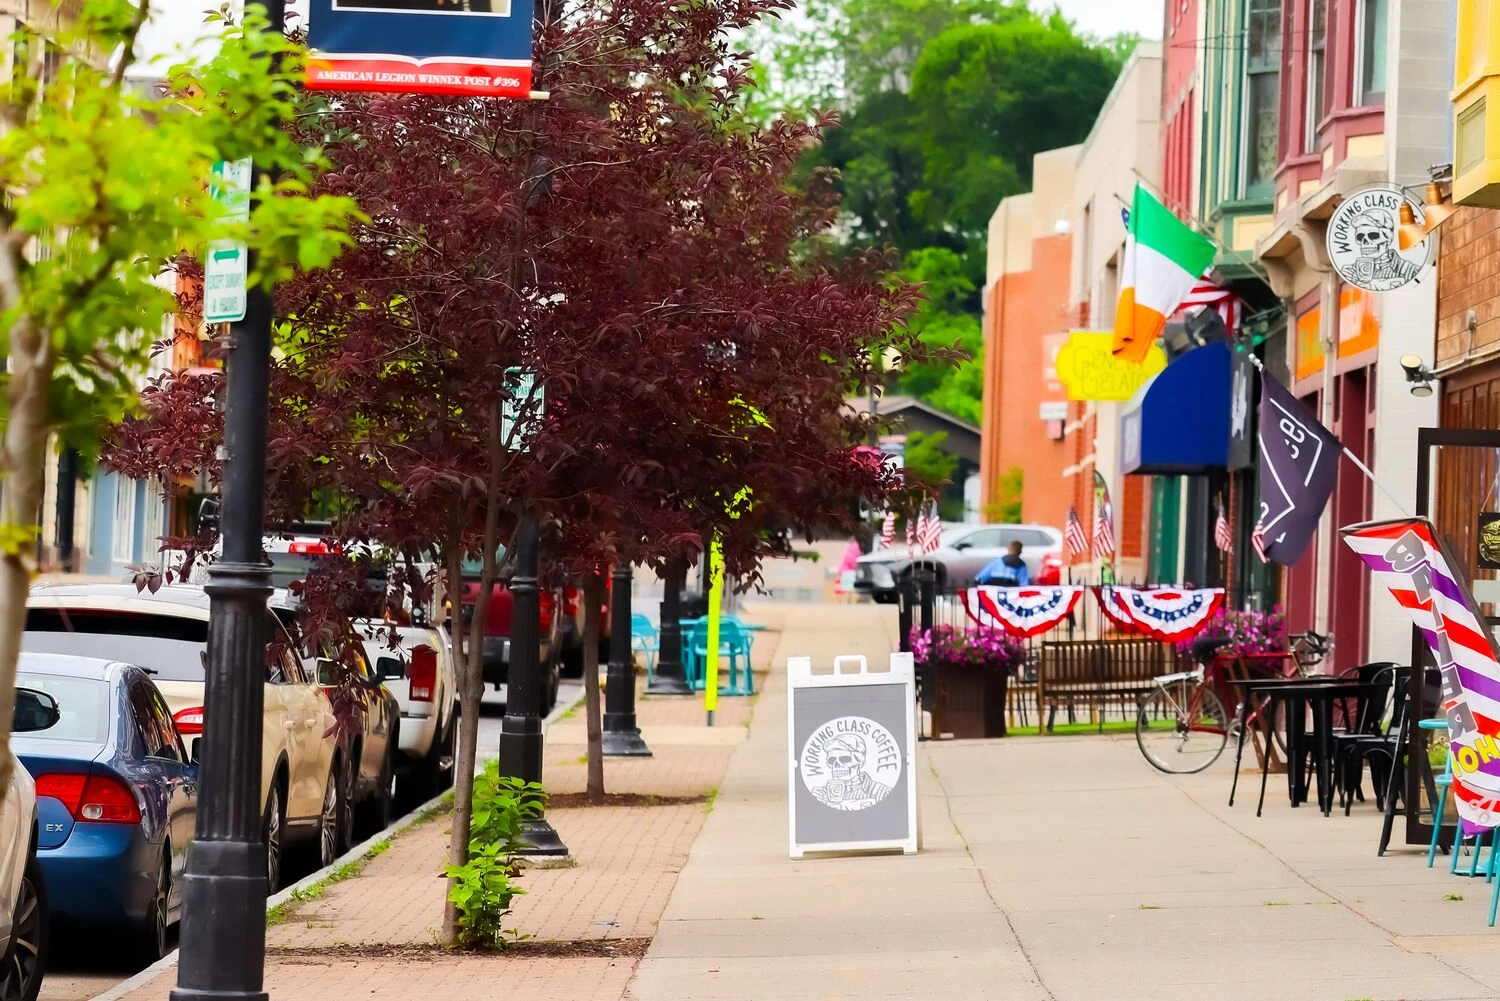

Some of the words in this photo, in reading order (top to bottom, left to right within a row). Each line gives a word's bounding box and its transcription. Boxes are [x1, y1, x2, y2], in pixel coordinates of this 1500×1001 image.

[317, 70, 373, 83] AMERICAN
[375, 72, 416, 84] LEGION
[419, 73, 462, 85] WINNEK
[464, 75, 490, 87] POST
[493, 75, 520, 88] #396
[1334, 200, 1362, 254] WORKING
[1365, 194, 1398, 210] CLASS
[804, 726, 834, 777] WORKING
[837, 719, 871, 735] CLASS
[871, 729, 898, 773] COFFEE
[45, 823, 63, 832] EX
